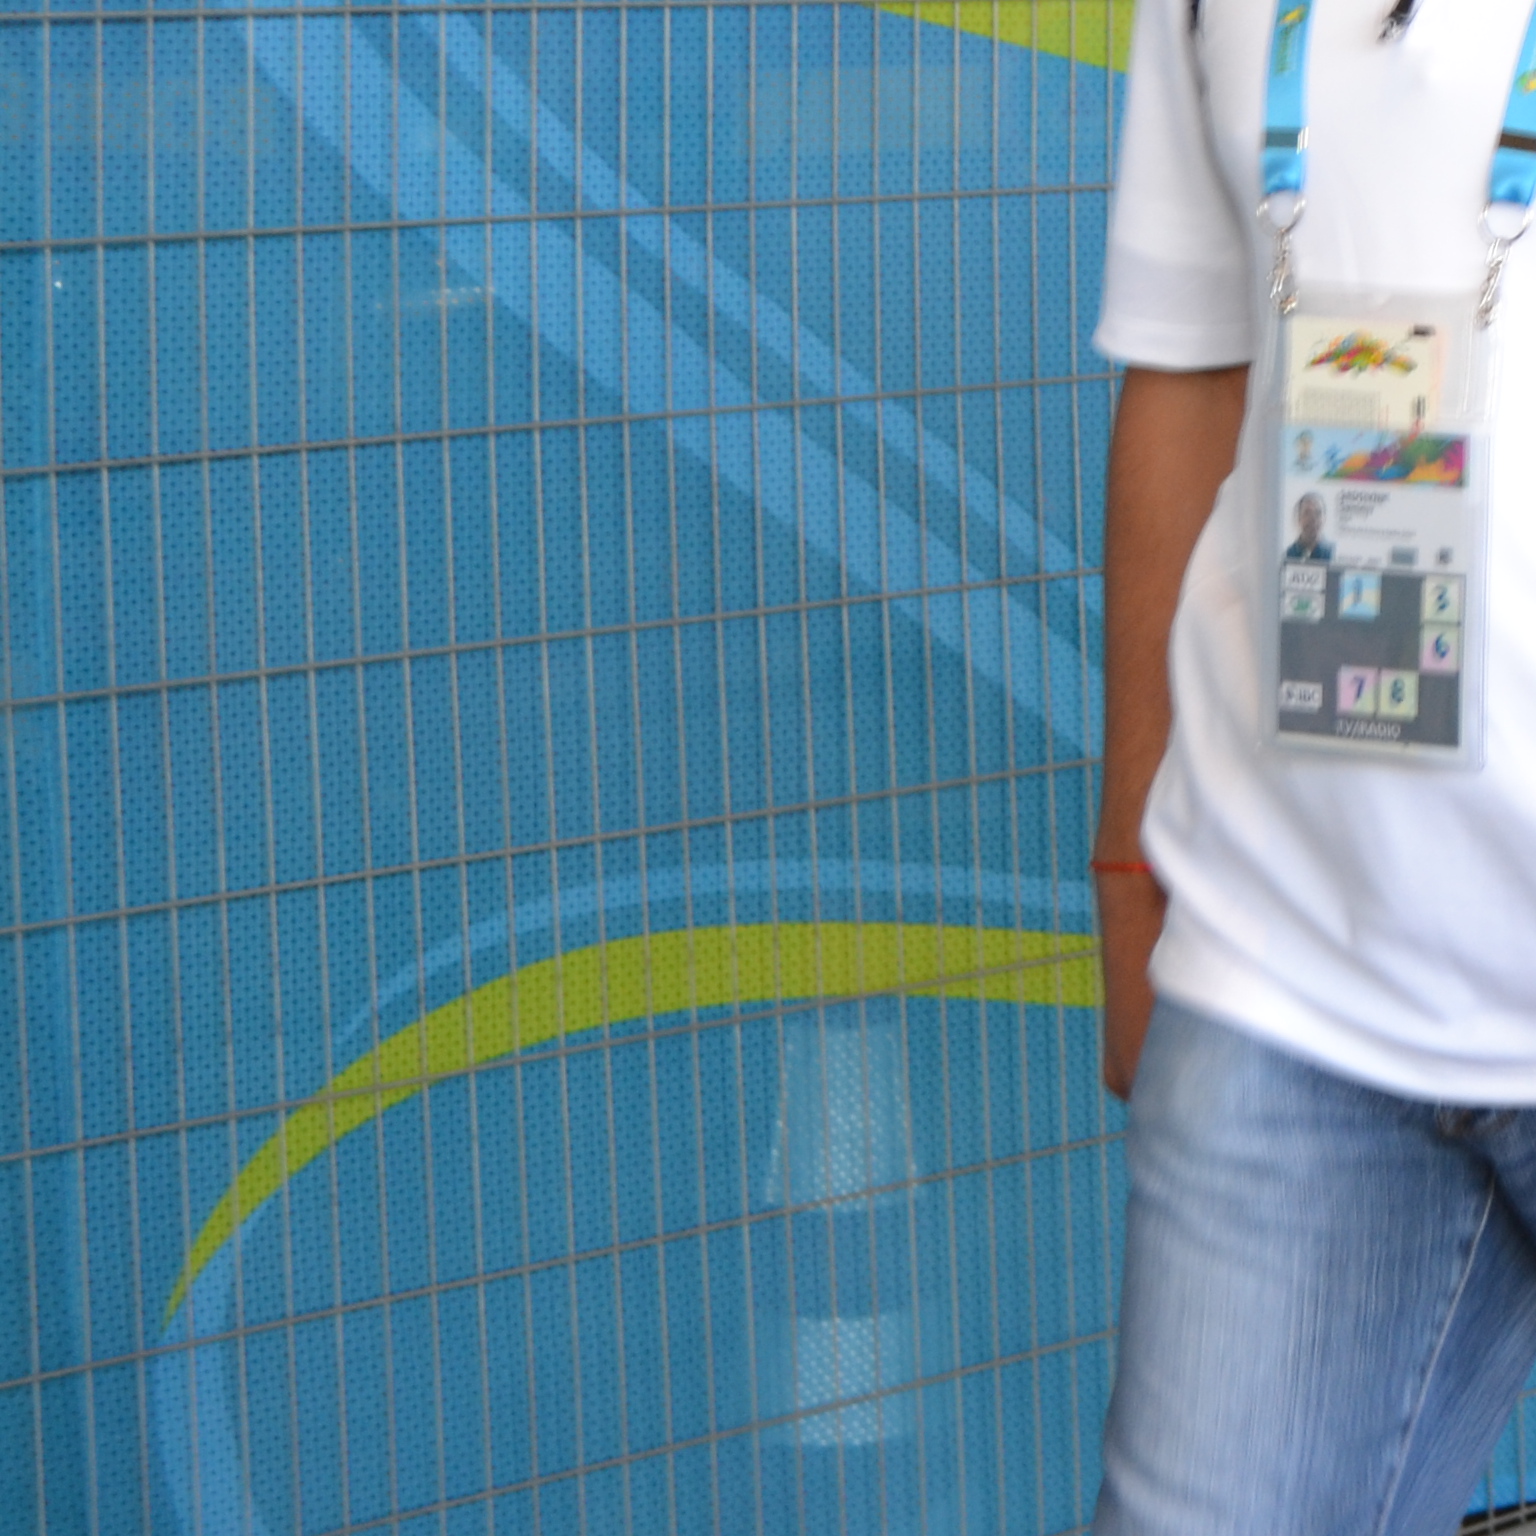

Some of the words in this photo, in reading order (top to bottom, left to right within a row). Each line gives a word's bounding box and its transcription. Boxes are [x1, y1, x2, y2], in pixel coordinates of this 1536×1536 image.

[1434, 632, 1450, 659] 6
[1353, 675, 1366, 700] 7
[1336, 719, 1401, 739] TV/RADIO
